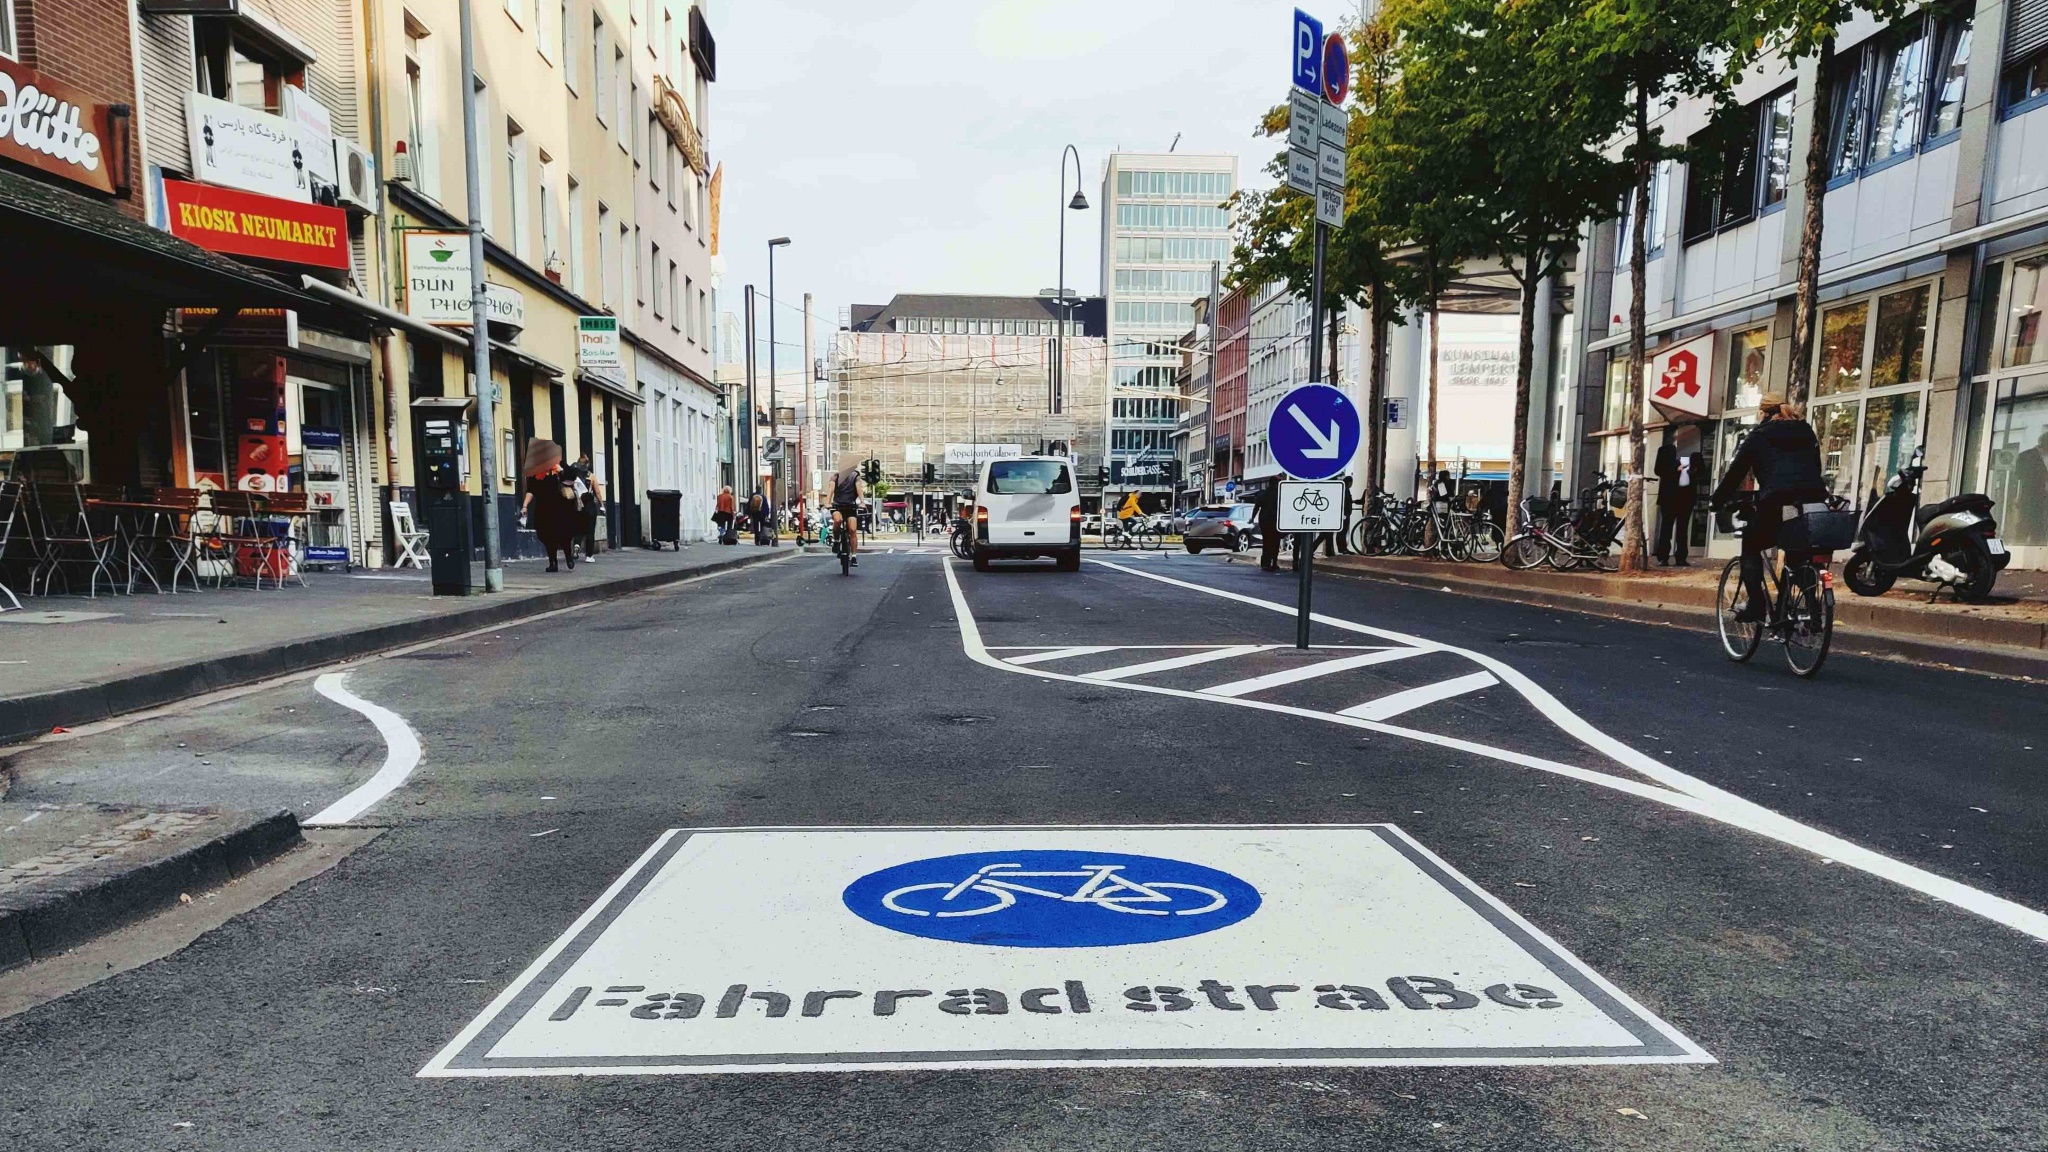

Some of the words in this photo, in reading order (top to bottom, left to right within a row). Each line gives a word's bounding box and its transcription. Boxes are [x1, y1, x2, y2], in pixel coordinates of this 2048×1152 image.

[1298, 21, 1313, 76] P
[1322, 115, 1345, 136] Ladezone
[179, 202, 239, 234] KIOSK
[240, 213, 337, 248] NEUMARKT
[581, 319, 616, 328] IMBISS
[581, 334, 603, 344] Thai
[1443, 350, 1518, 361] KUNSTHAU
[1451, 363, 1517, 375] LEMPERT
[1301, 515, 1320, 525] frei
